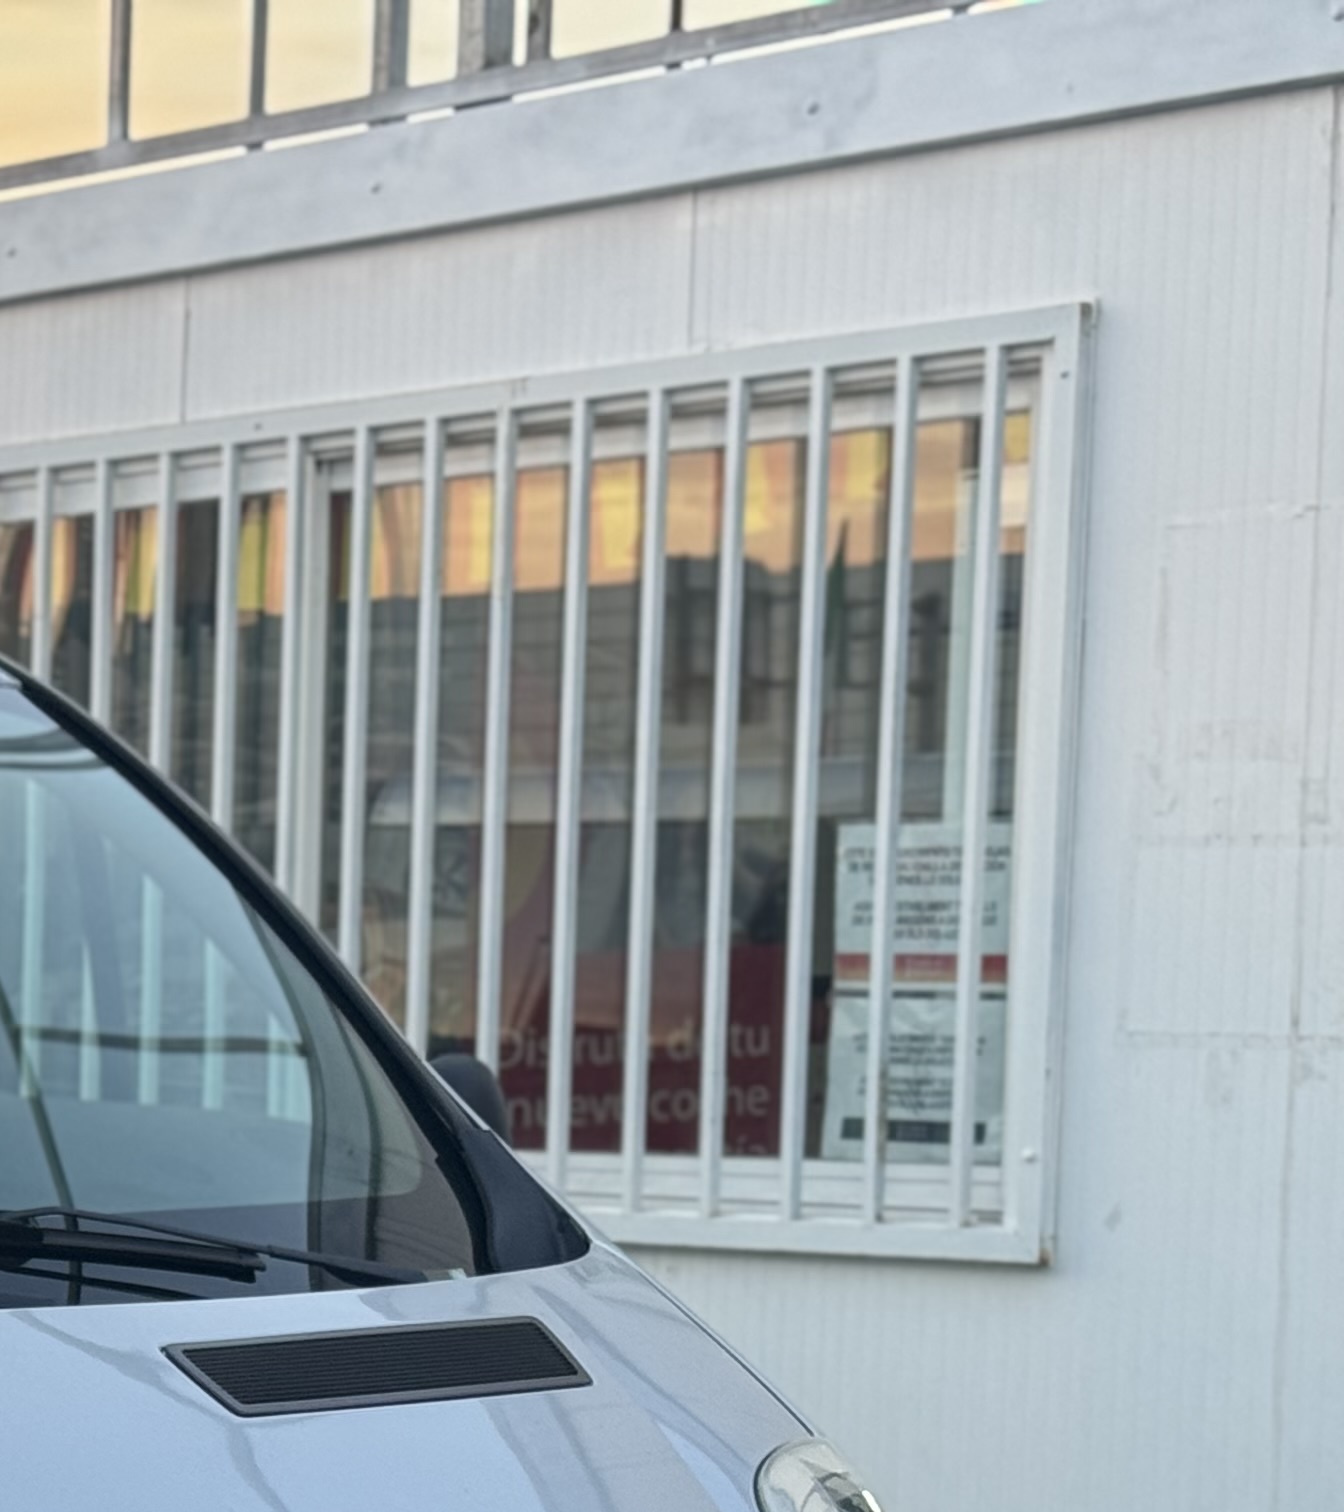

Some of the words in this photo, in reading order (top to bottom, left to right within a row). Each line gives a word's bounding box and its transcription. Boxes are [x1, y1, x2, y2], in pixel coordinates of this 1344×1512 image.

[500, 1026, 656, 1068] Disru
[730, 1022, 770, 1059] tu
[650, 1084, 770, 1123] coe
